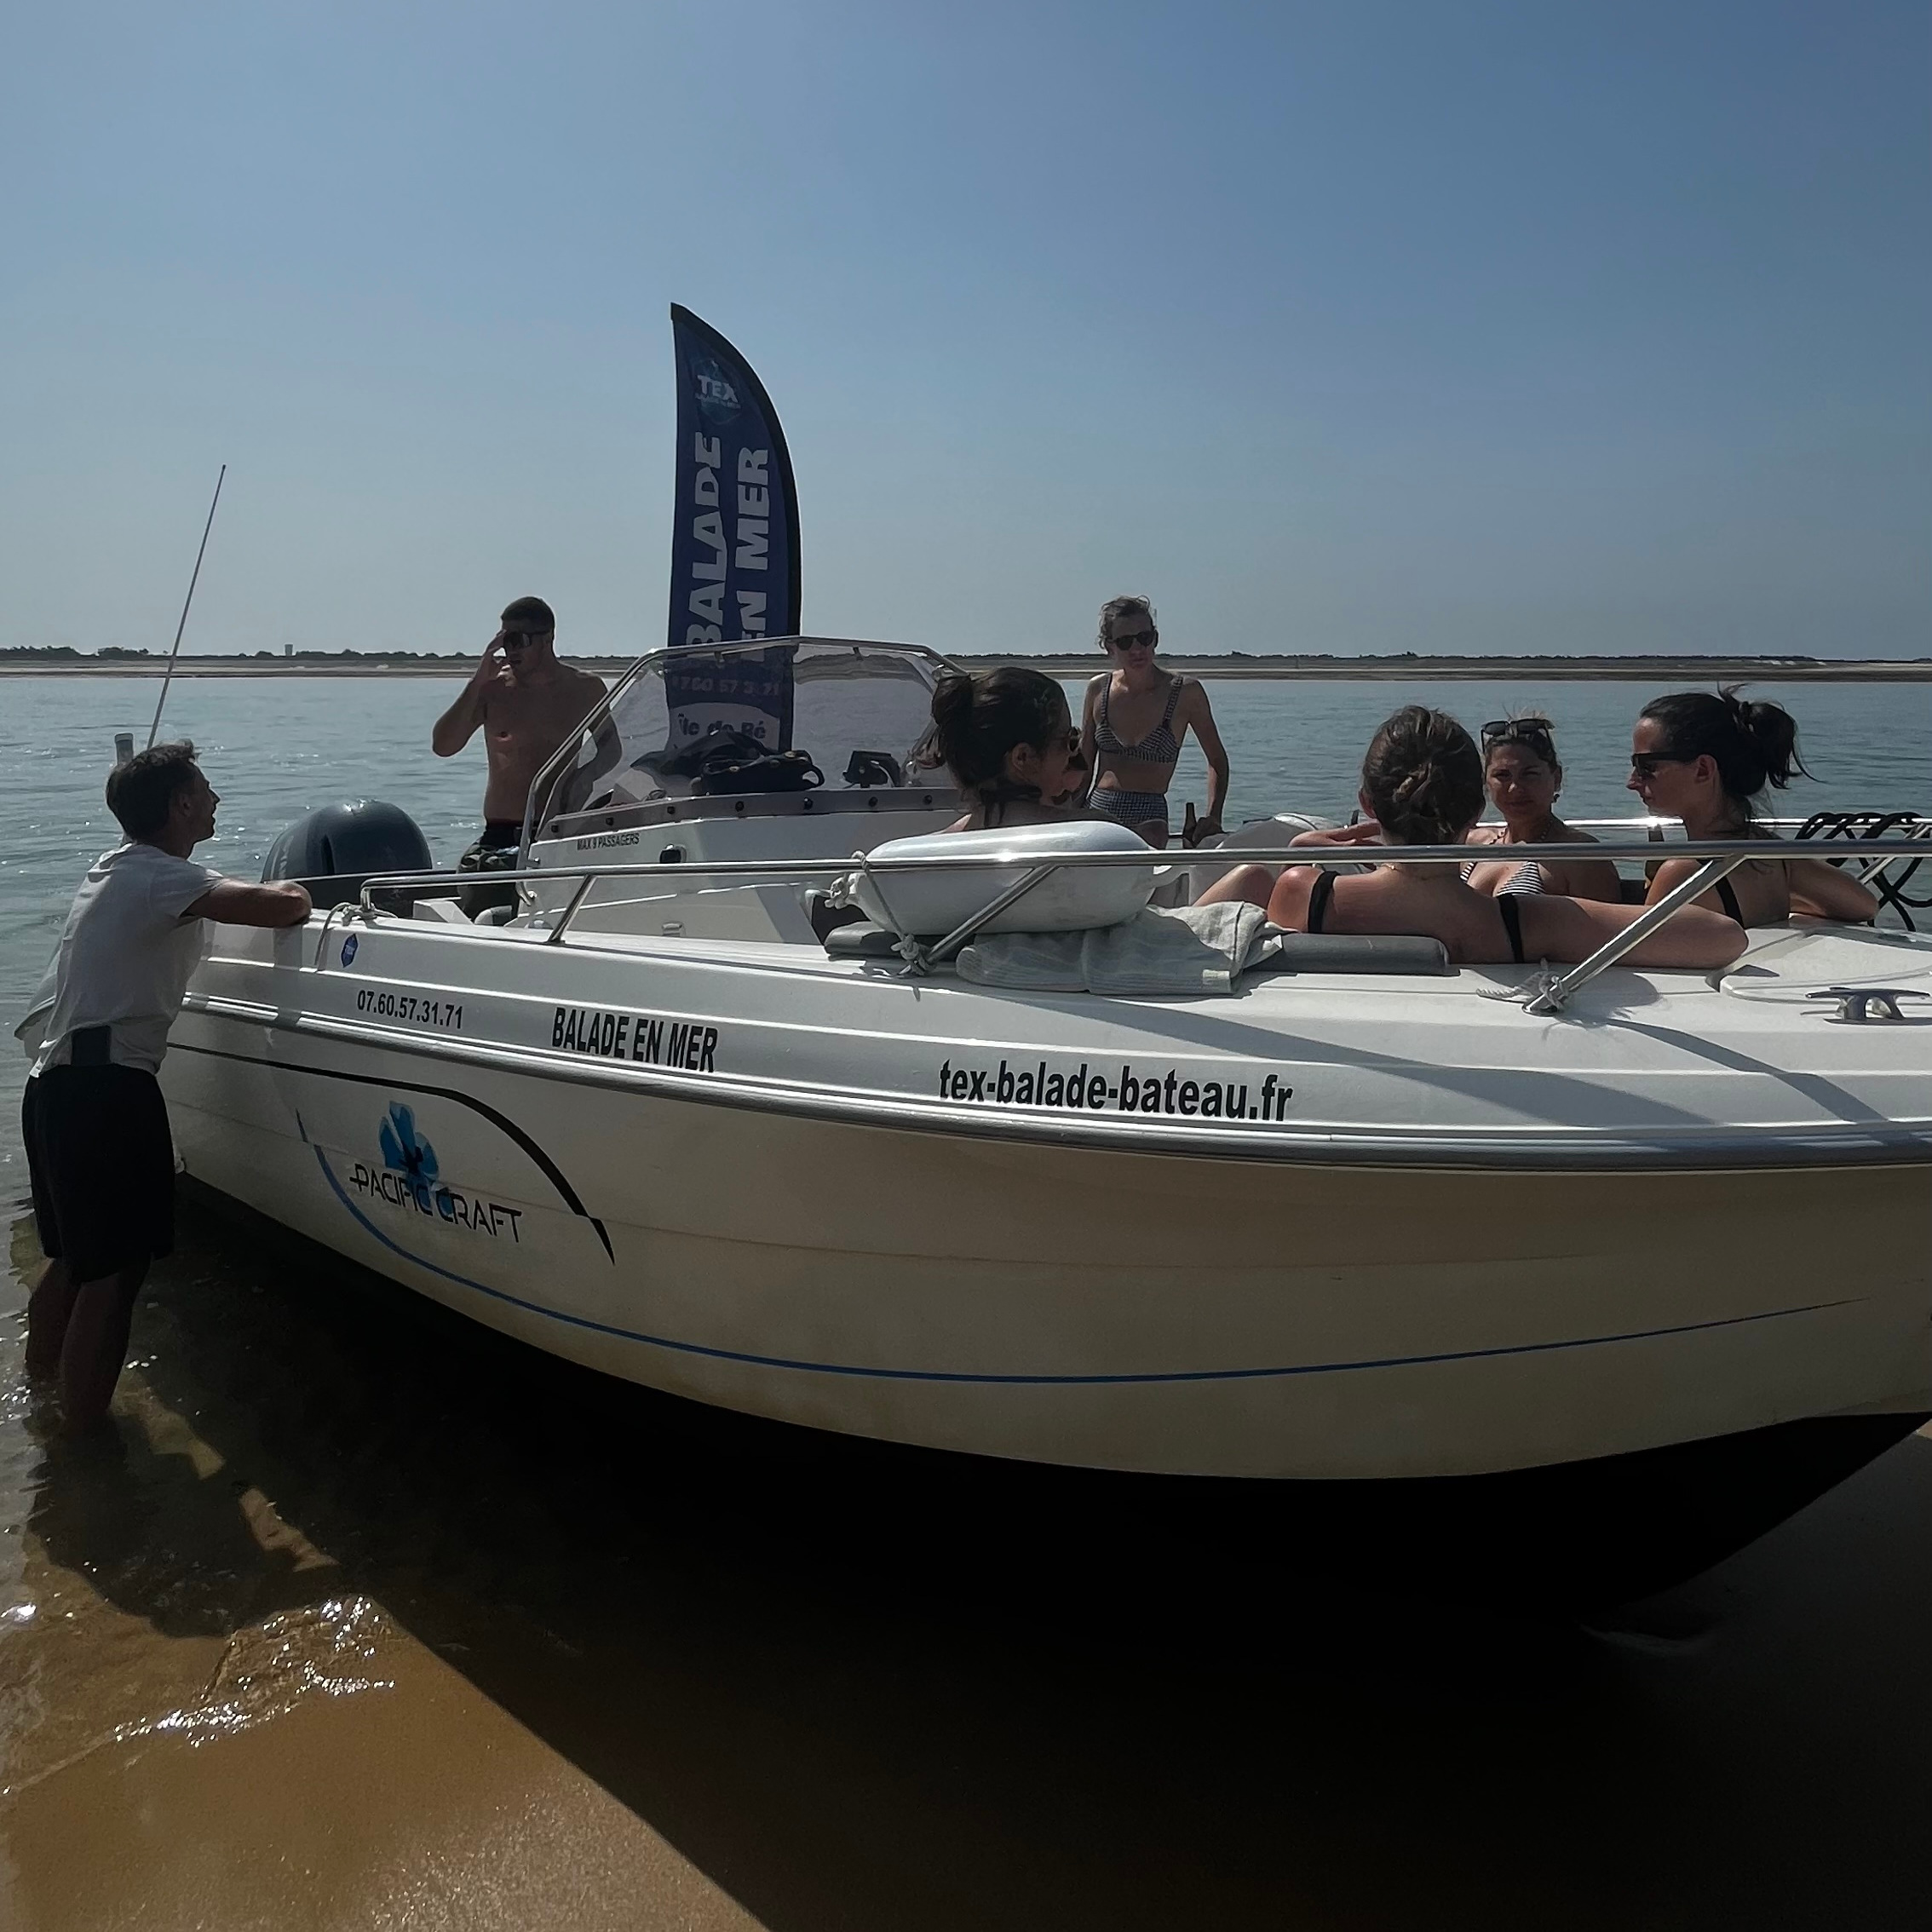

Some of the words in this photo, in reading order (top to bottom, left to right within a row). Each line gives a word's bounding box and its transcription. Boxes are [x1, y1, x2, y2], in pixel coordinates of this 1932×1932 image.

[697, 375, 739, 403] TEX
[735, 446, 769, 570] MER
[686, 431, 727, 659] BALADE
[598, 832, 639, 848] PASSAGERS
[356, 989, 463, 1029] 07.60.57.31.71
[550, 1007, 627, 1060] BALADE
[633, 1018, 664, 1064] EN
[666, 1022, 718, 1073] MER
[939, 1059, 1293, 1122] tex-balade-bateau.fr
[349, 1163, 434, 1217] PACIFIC
[435, 1187, 522, 1243] CRAFT
